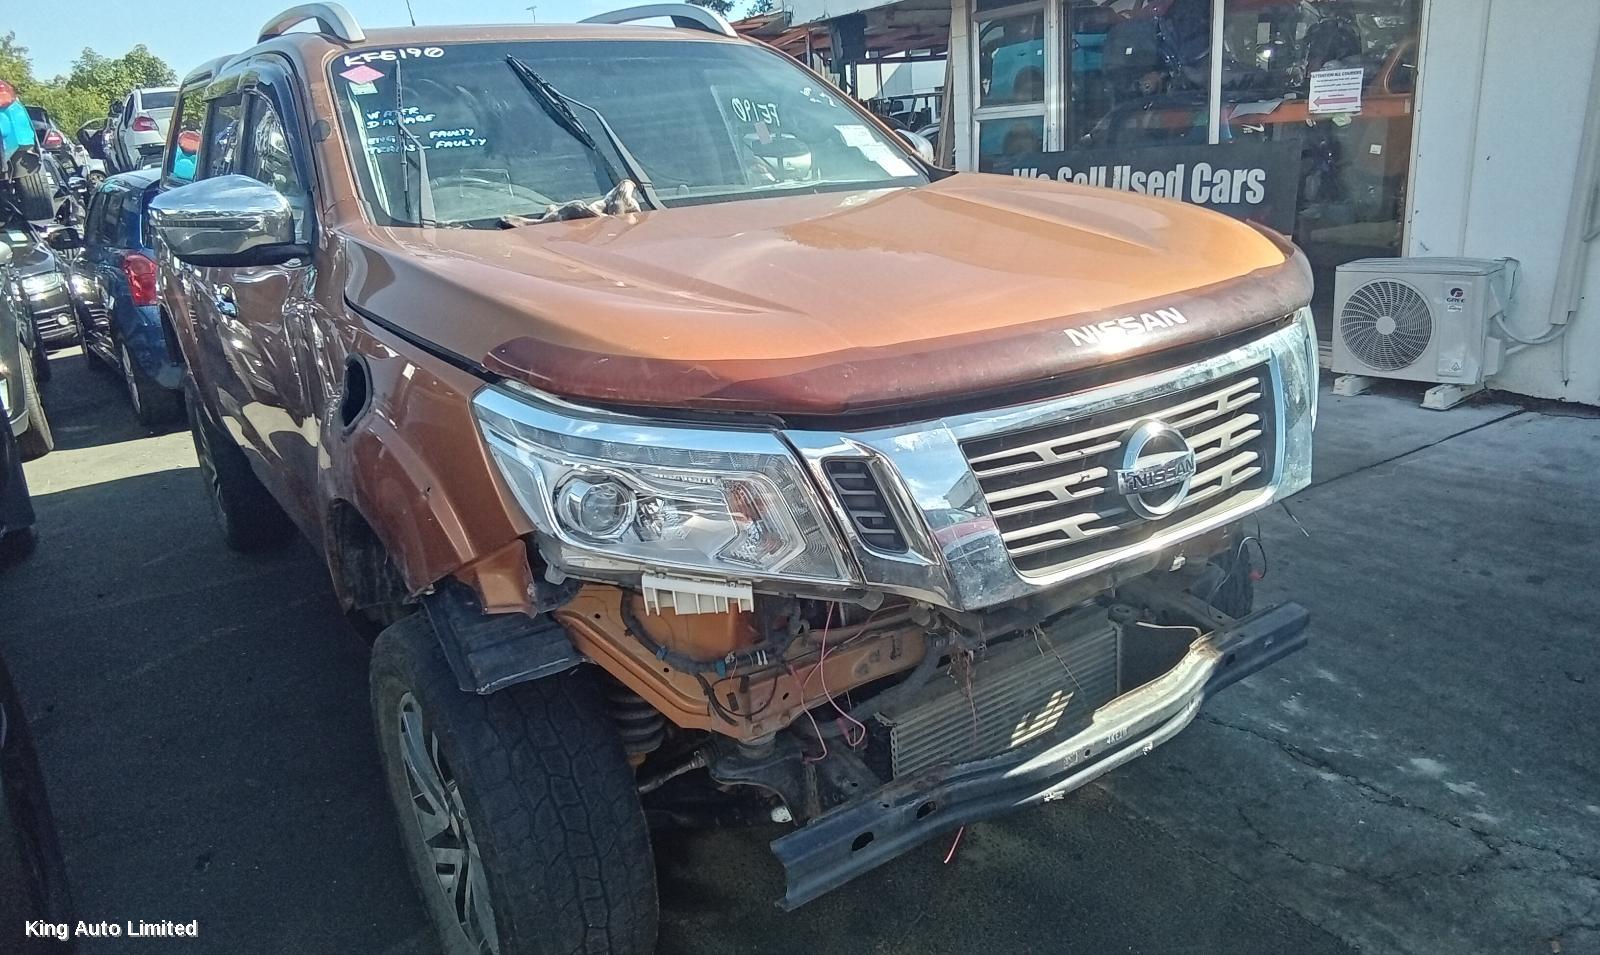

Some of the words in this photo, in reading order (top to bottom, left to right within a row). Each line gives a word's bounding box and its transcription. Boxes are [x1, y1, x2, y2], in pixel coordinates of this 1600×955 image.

[429, 128, 475, 139] FAULTY
[435, 138, 487, 149] FAULTY
[1057, 166, 1107, 188] ll
[1112, 163, 1186, 202] Used
[1190, 162, 1267, 204] Cars
[1063, 306, 1189, 348] NISSAN
[1131, 453, 1195, 490] NISSAN
